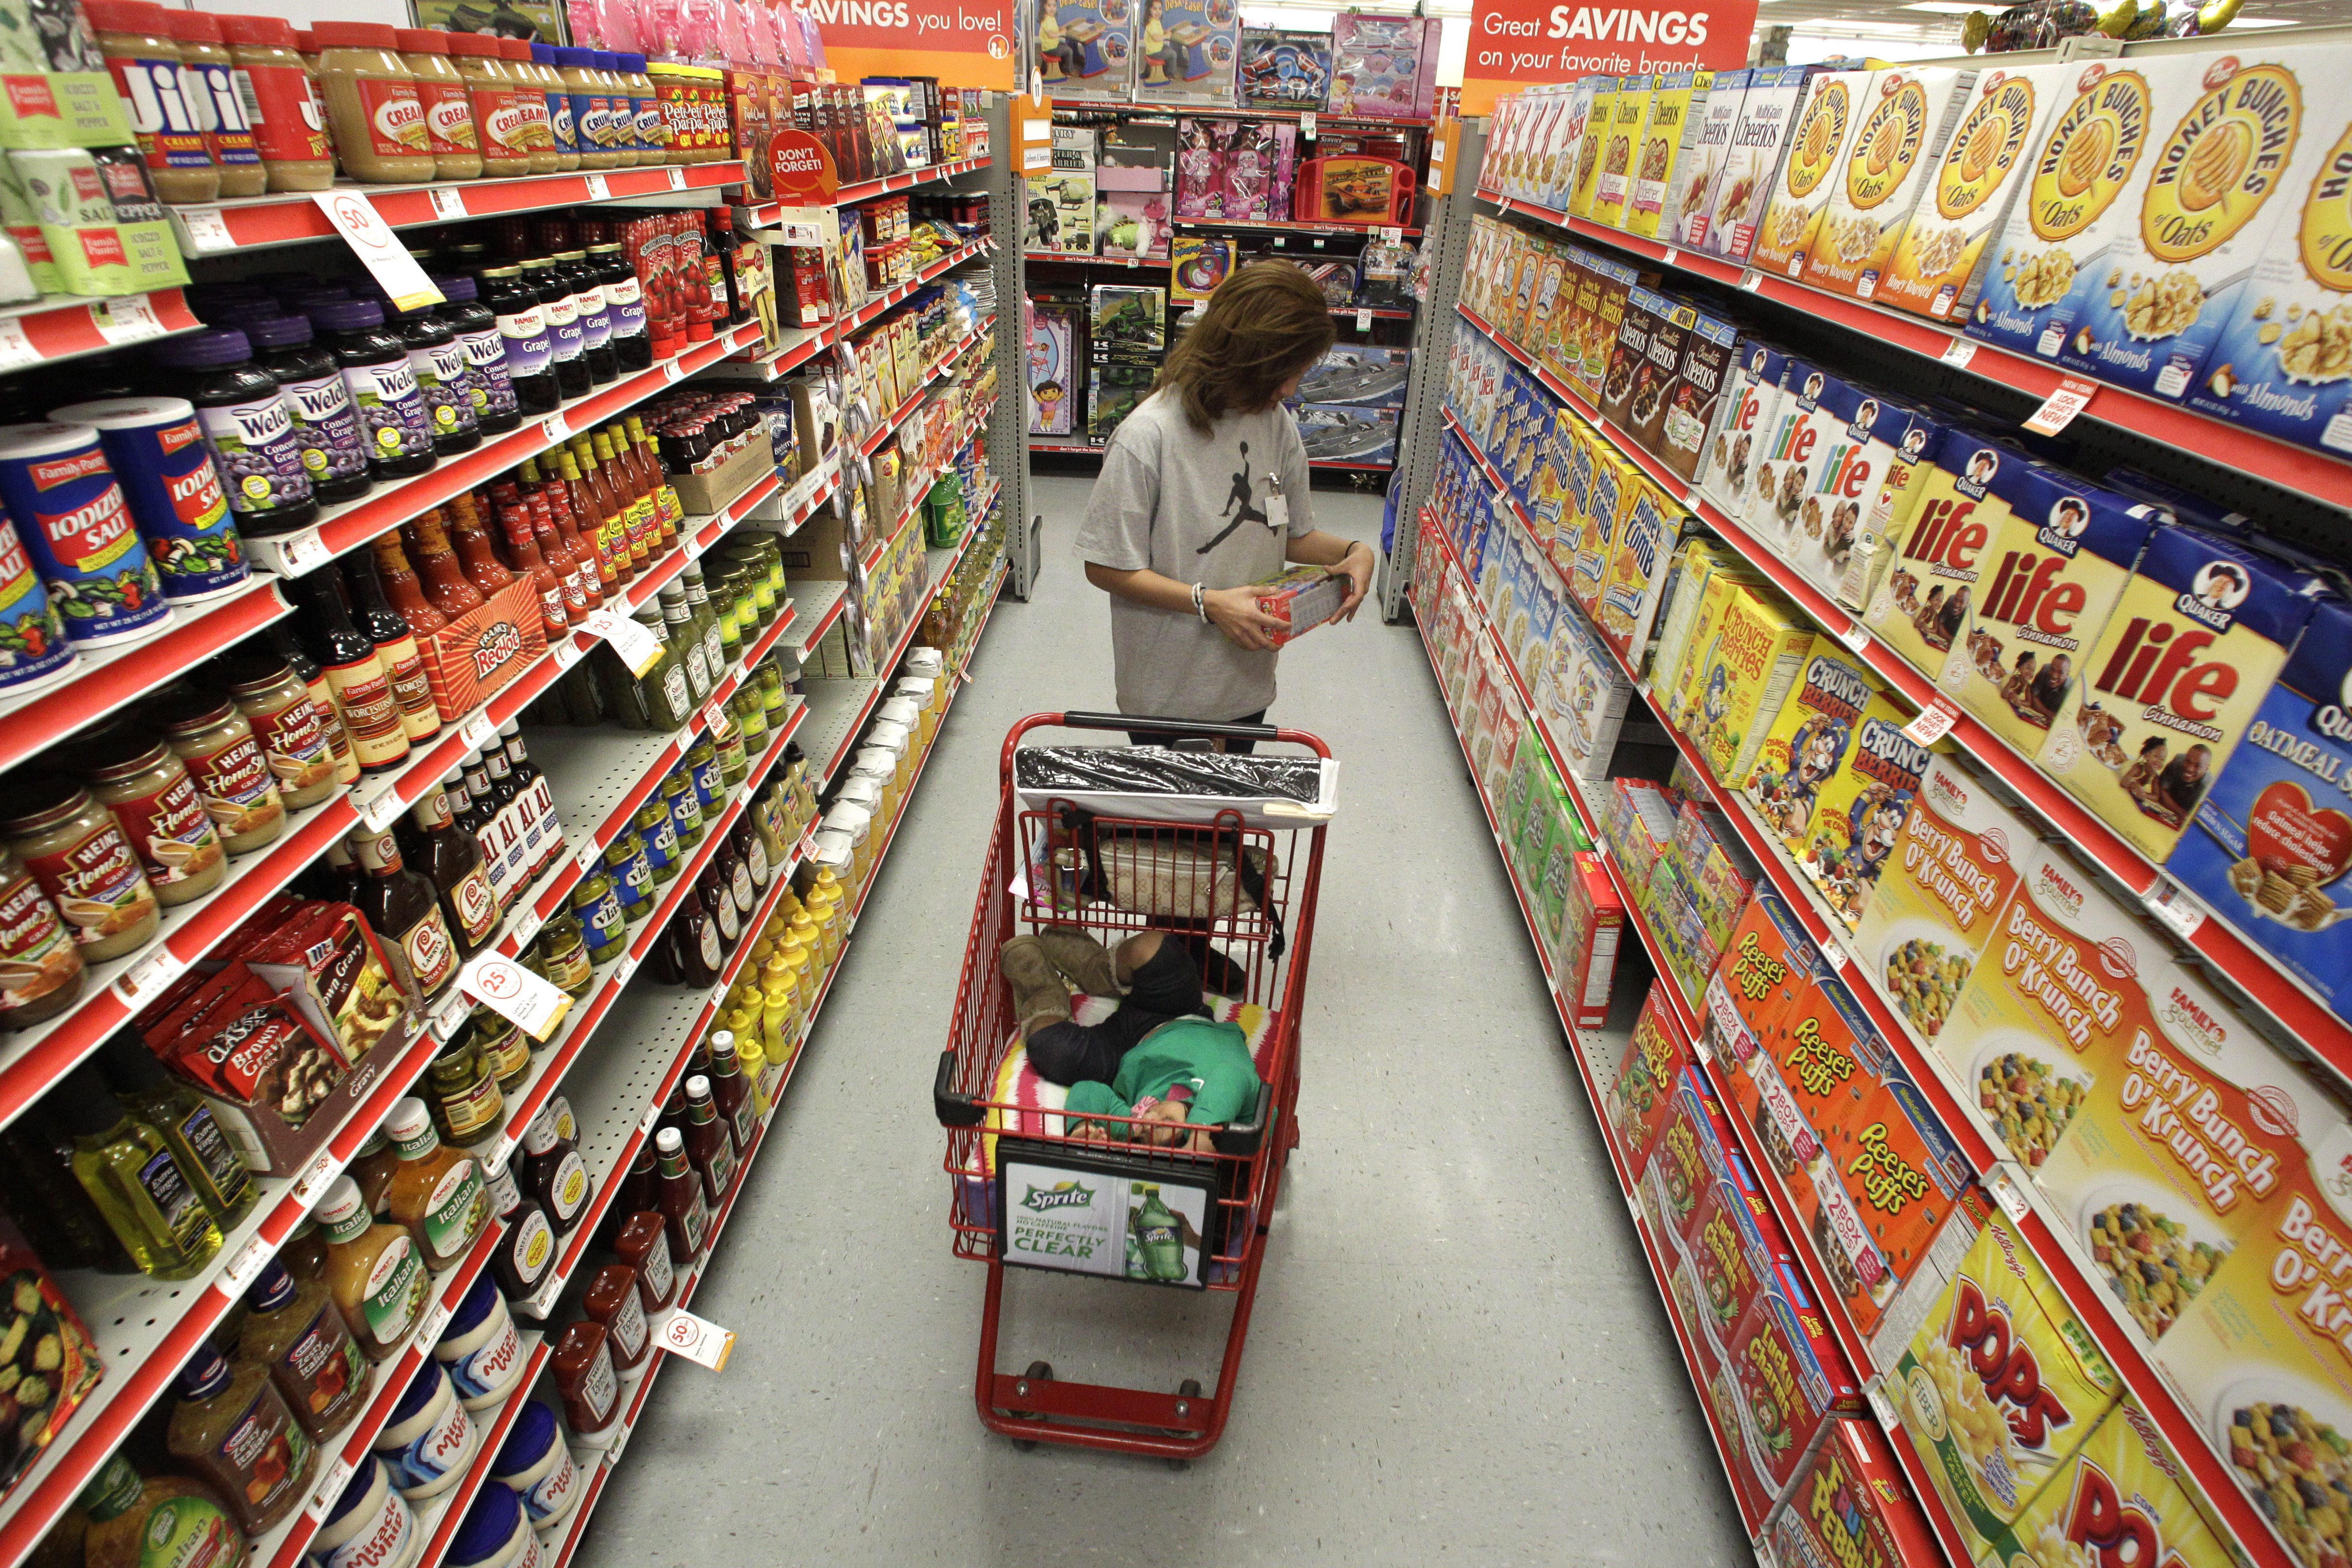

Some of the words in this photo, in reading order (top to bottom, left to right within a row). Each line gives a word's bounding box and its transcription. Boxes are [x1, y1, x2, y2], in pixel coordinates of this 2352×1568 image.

[790, 0, 909, 27] SAVINGS
[918, 14, 950, 35] you
[959, 8, 1002, 32] love!
[1483, 12, 1541, 38] Great
[1547, 6, 1710, 46] SAVINGS
[1478, 50, 1503, 67] on
[1510, 52, 1555, 77] your
[1560, 46, 1631, 74] favorite
[2205, 60, 2239, 85] Post
[1735, 118, 1780, 148] Cheerios
[1855, 103, 1898, 159] HONEY
[1899, 88, 1927, 165] BUNCHES
[1948, 94, 1997, 165] HONEY
[1996, 86, 2033, 170] BUNCHES
[2040, 89, 2096, 177] HONEY
[2100, 80, 2144, 184] BUNCHES
[2156, 87, 2230, 186] HONEY
[2235, 77, 2290, 196] BUNCHES
[775, 159, 822, 173] FORGET!
[777, 147, 814, 160] DON'T
[587, 316, 610, 329] Grape
[622, 306, 643, 318] Grape
[1994, 312, 2035, 337] Almonds
[523, 339, 549, 353] Grape
[559, 326, 582, 340] Grape
[1618, 318, 1647, 354] Cheerios
[1660, 326, 1679, 346] Chocolate
[1647, 332, 1678, 370] Cheerios
[1697, 344, 1720, 366] Chocolate
[1682, 349, 1718, 393] Cheerios
[2037, 408, 2071, 428] NEW!
[2048, 401, 2077, 420] WHAT'S
[2056, 393, 2077, 409] LOOK
[2230, 382, 2250, 396] with
[2244, 382, 2319, 422] Almonds
[165, 428, 191, 446] Family
[1768, 414, 1817, 463] life
[1815, 444, 1871, 498] life
[1956, 478, 1986, 500] QUAKER
[49, 484, 124, 541] IODIZED
[87, 513, 127, 552] SALT
[630, 542, 642, 552] HOT
[1902, 498, 1989, 569] life
[2038, 527, 2079, 555] QUAKER
[1929, 561, 1979, 583] Cinnamon
[1979, 551, 2087, 636] life
[595, 619, 612, 632] 25
[2177, 593, 2232, 631] QUAKER
[476, 626, 522, 678] RedHot
[480, 622, 508, 648] FRANK'S
[2016, 624, 2079, 652] Cinnamon
[396, 659, 416, 672] Family
[2094, 616, 2240, 722] life
[1805, 655, 1874, 712] CRUNCH
[284, 700, 315, 727] HEINZ
[1799, 684, 1861, 730] BERRIES
[1928, 709, 1946, 726] LOOK
[1933, 696, 1947, 710] NEW
[1945, 703, 1960, 718] ITEM!
[2142, 703, 2225, 743] Cinnamon
[1912, 721, 1939, 742] NEW!
[220, 740, 257, 769] HEINZ
[2249, 720, 2342, 783] OATMEAL
[234, 791, 258, 804] Classic
[241, 774, 263, 790] GRAVY
[534, 782, 552, 816] A1
[499, 814, 517, 849] A1
[517, 797, 536, 832] A1
[77, 829, 121, 864] HEINZ
[481, 832, 500, 868] A1
[2253, 817, 2281, 840] reduce
[2281, 836, 2335, 876] cholesterol!
[2268, 810, 2306, 840] Oatmeal
[2305, 832, 2331, 858] helps
[1908, 806, 1957, 861] Berry
[1943, 843, 1998, 909] Bunch
[99, 883, 127, 903] Classic
[105, 868, 129, 886] GRAVY
[469, 894, 488, 925] LAWRY'S
[2034, 877, 2084, 920] gourmet
[422, 940, 442, 968] LAWRY'S
[1737, 931, 1788, 986] Reese's
[2006, 900, 2071, 969] Berry
[2054, 947, 2122, 1033] Bunch
[1729, 957, 1772, 1001] Puffs
[2002, 940, 2027, 974] O'
[2019, 957, 2094, 1052] Krunch
[522, 1002, 538, 1020] Marinade
[231, 1025, 281, 1070] Brown
[243, 1033, 286, 1077] Gravy
[1793, 1017, 1857, 1081] Reese's
[350, 1064, 375, 1098] Gravy
[1784, 1045, 1837, 1097] Puffs
[2125, 1028, 2206, 1109] Berry
[2185, 1082, 2278, 1197] Bunch
[1858, 1122, 1931, 1201] Reese's
[2119, 1073, 2152, 1113] O'
[2140, 1095, 2241, 1215] Krunch
[1028, 1188, 1087, 1210] Sprite
[1848, 1153, 1908, 1215] Puffs
[438, 1180, 475, 1225] Italian
[1015, 1226, 1105, 1247] PERFECTLY
[1030, 1221, 1067, 1231] CAFFEINE
[1036, 1217, 1070, 1227] NATURAL
[1071, 1223, 1108, 1232] FLAVORS
[1145, 1233, 1174, 1244] Sprite
[1715, 1205, 1741, 1255] Lucky
[1836, 1217, 1856, 1252] TOPS!
[1014, 1237, 1093, 1259] CLEAR
[1704, 1221, 1736, 1291] Charms
[1991, 1224, 2028, 1279] Kellogg's
[377, 1258, 415, 1309] Italian
[297, 1341, 323, 1370] Zesty
[299, 1343, 331, 1379] Italian
[1763, 1322, 1794, 1395] Lucky
[1749, 1338, 1790, 1420] Charms
[1910, 1378, 1941, 1432] FIBER
[232, 1427, 261, 1460] Zesty
[234, 1429, 270, 1469] Italian
[2122, 1403, 2179, 1479] Kellogg's
[2133, 1493, 2162, 1523] CORN
[347, 1494, 399, 1568] Miracle
